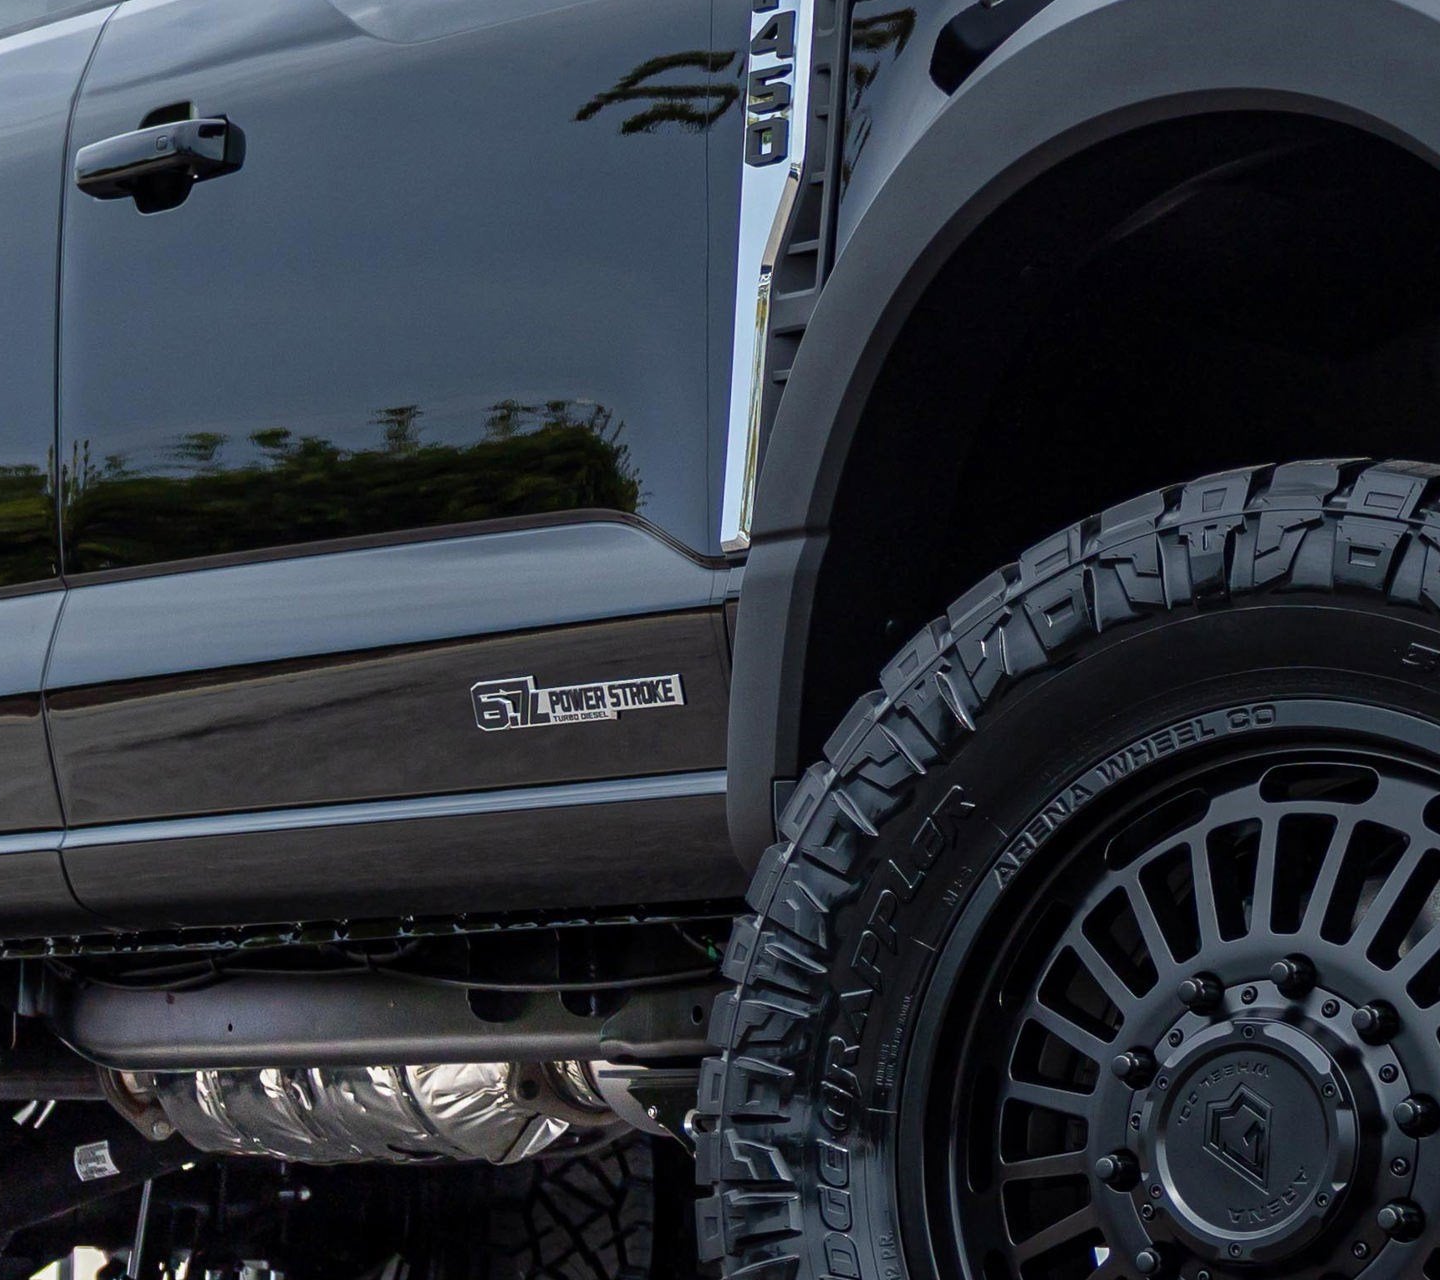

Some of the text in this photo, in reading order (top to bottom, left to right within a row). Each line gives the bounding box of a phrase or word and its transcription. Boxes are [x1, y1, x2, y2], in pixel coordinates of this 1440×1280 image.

[548, 686, 607, 713] POWER
[608, 678, 676, 707] STROKE
[553, 711, 609, 722] TURBO DIESEL
[993, 704, 1275, 889] ARENA WHEEL CO
[820, 784, 976, 1132] GRAPPLER
[1201, 1059, 1273, 1088] WHEEL
[1226, 1165, 1309, 1224] ARENA
